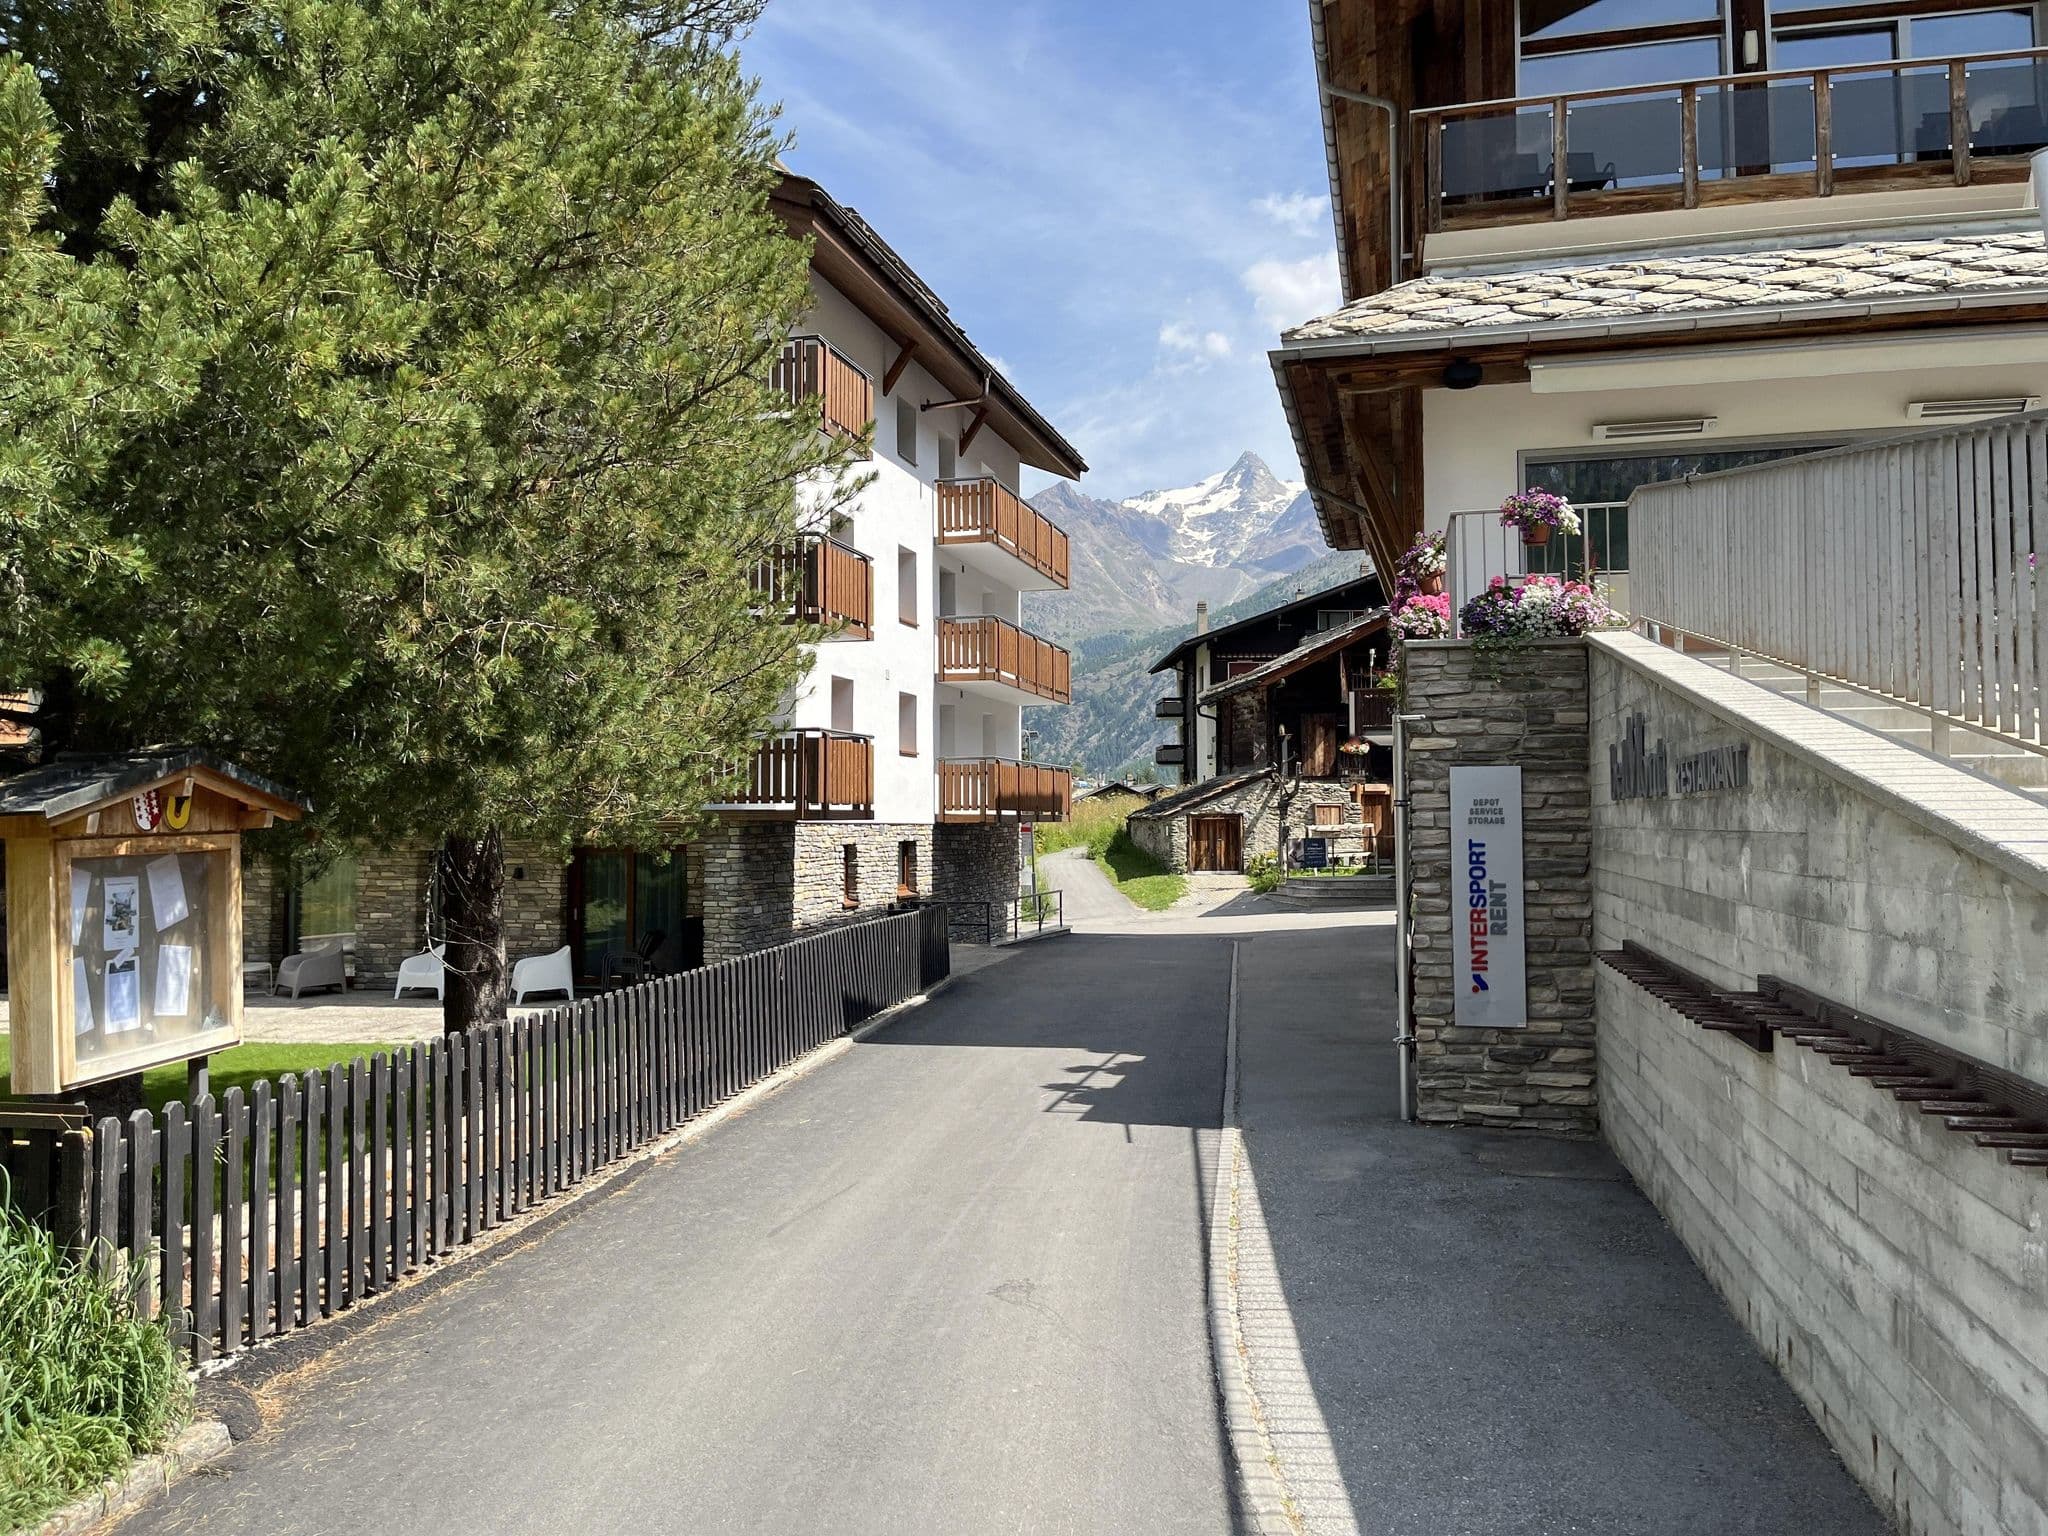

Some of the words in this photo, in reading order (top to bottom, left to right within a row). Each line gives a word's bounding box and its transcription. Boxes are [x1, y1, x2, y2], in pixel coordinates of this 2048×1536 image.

[1675, 743, 1748, 793] RESTAURANT
[1470, 807, 1504, 815] SERVICE
[1473, 798, 1500, 806] DEPOT
[1468, 816, 1506, 825] STORAGE
[1469, 838, 1489, 972] INTERSPORT
[1489, 879, 1508, 936] RENT
